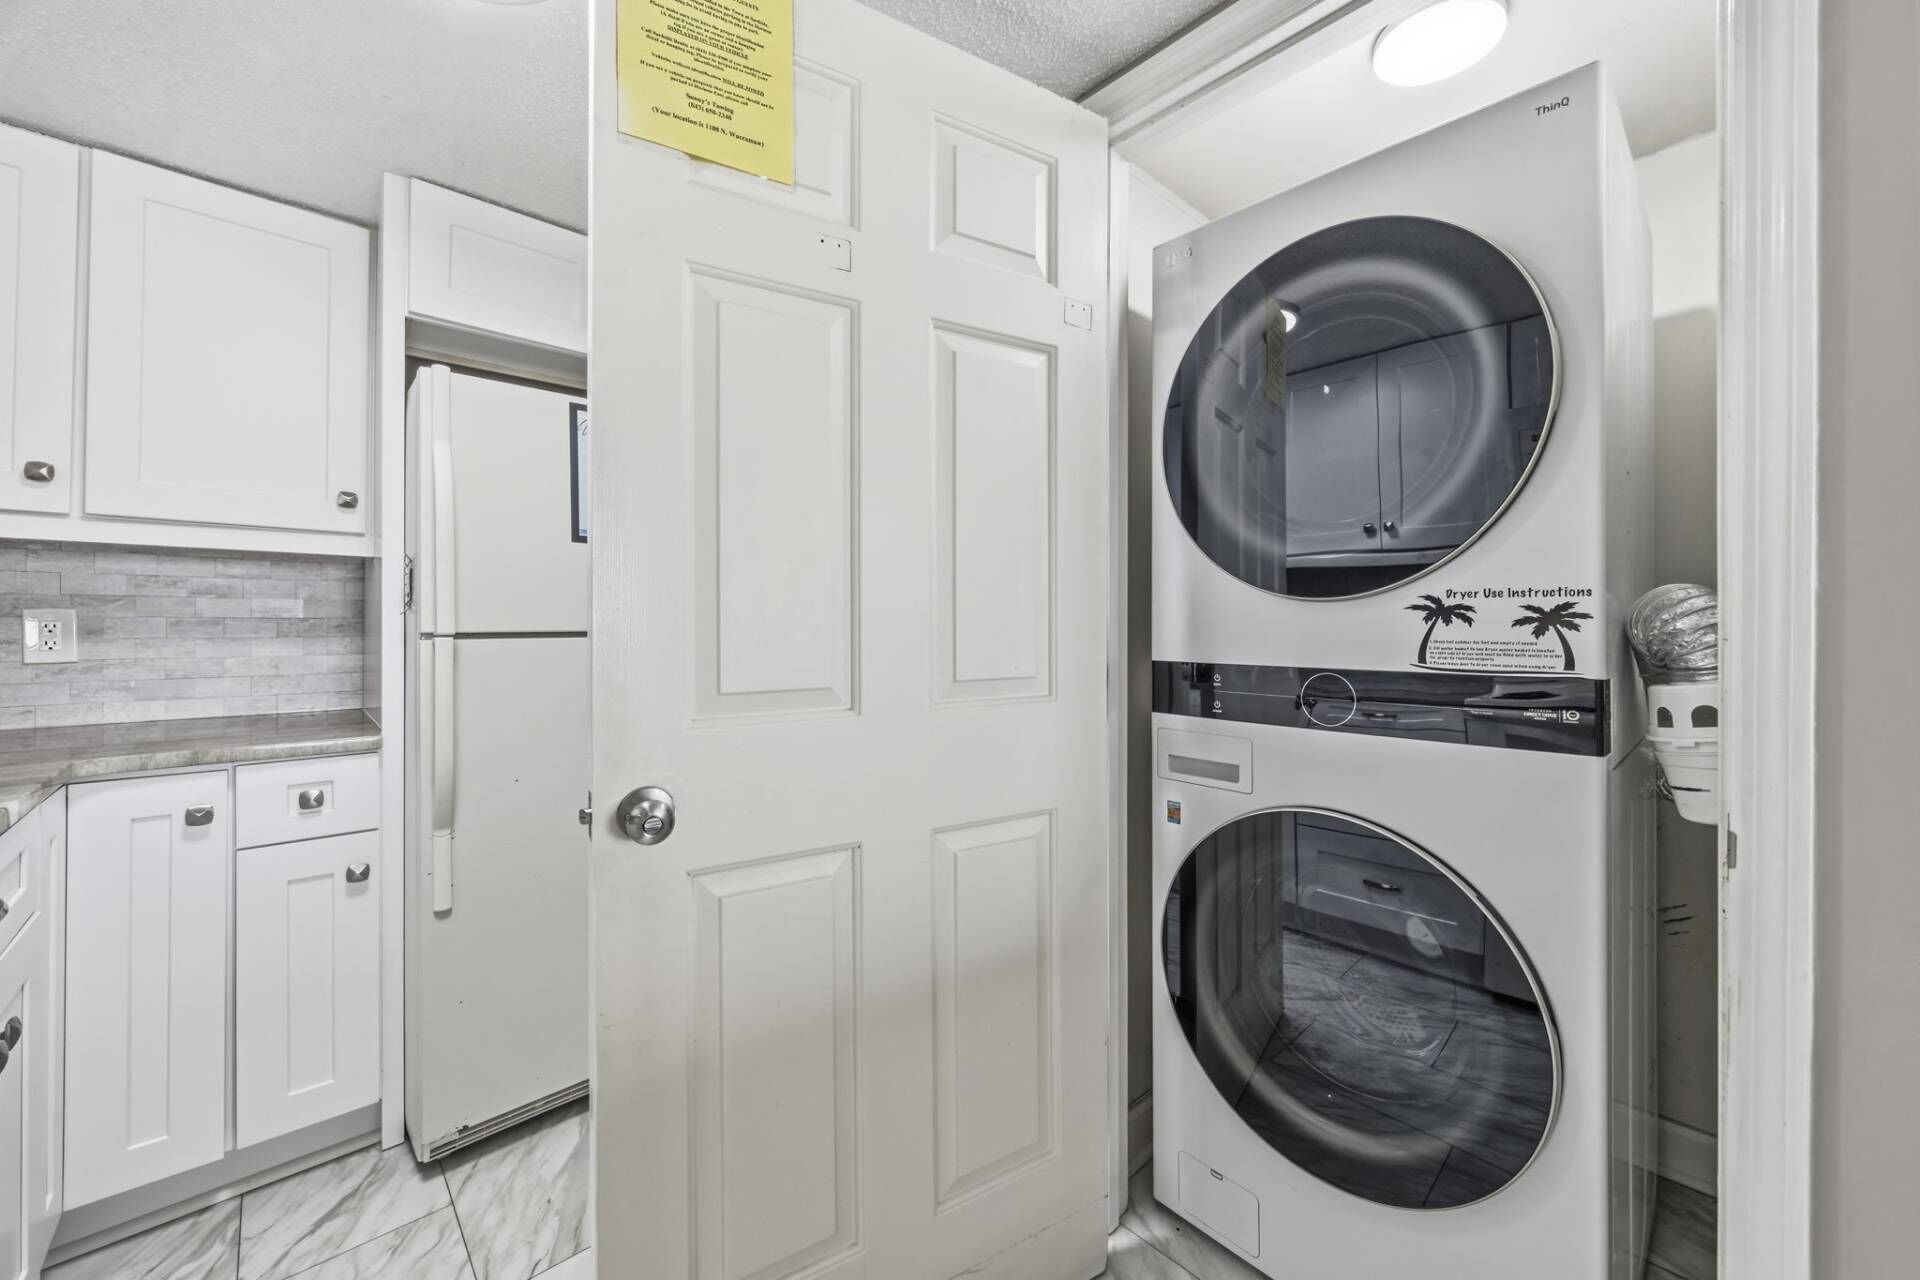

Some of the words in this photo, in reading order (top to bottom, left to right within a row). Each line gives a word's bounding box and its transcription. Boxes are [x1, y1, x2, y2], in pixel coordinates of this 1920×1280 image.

[1536, 96, 1570, 116] ThinQ
[672, 111, 697, 126] location
[1446, 588, 1480, 600] Dryer
[1484, 588, 1504, 598] Use
[1507, 586, 1592, 598] Instructions
